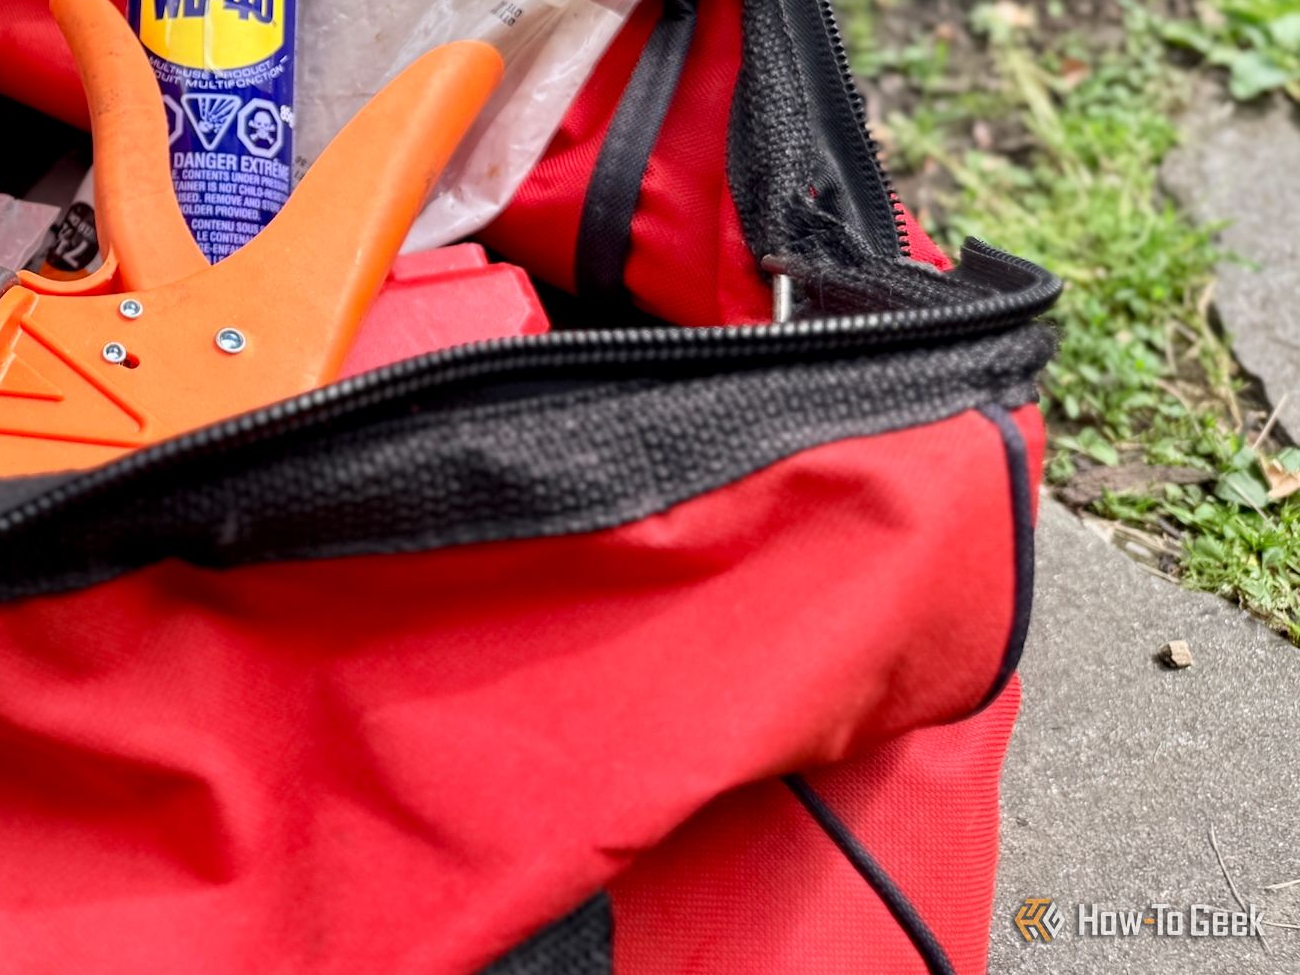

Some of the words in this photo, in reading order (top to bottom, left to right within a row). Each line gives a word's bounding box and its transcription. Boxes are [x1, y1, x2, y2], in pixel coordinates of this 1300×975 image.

[185, 65, 283, 89] MULTIFONCTION
[215, 60, 271, 80] PRODUCT
[173, 152, 237, 170] DANGER
[240, 156, 290, 182] EXTRÊME
[182, 170, 229, 181] CONTENTS
[231, 172, 260, 183] UNDER
[208, 183, 217, 191] IS
[219, 184, 237, 193] NOT
[204, 193, 242, 206] REMOVE
[243, 197, 260, 208] AND
[215, 206, 260, 220] PROVIDED.
[191, 219, 235, 231] CONTENU
[236, 222, 259, 234] SOUS
[197, 231, 208, 241] LE
